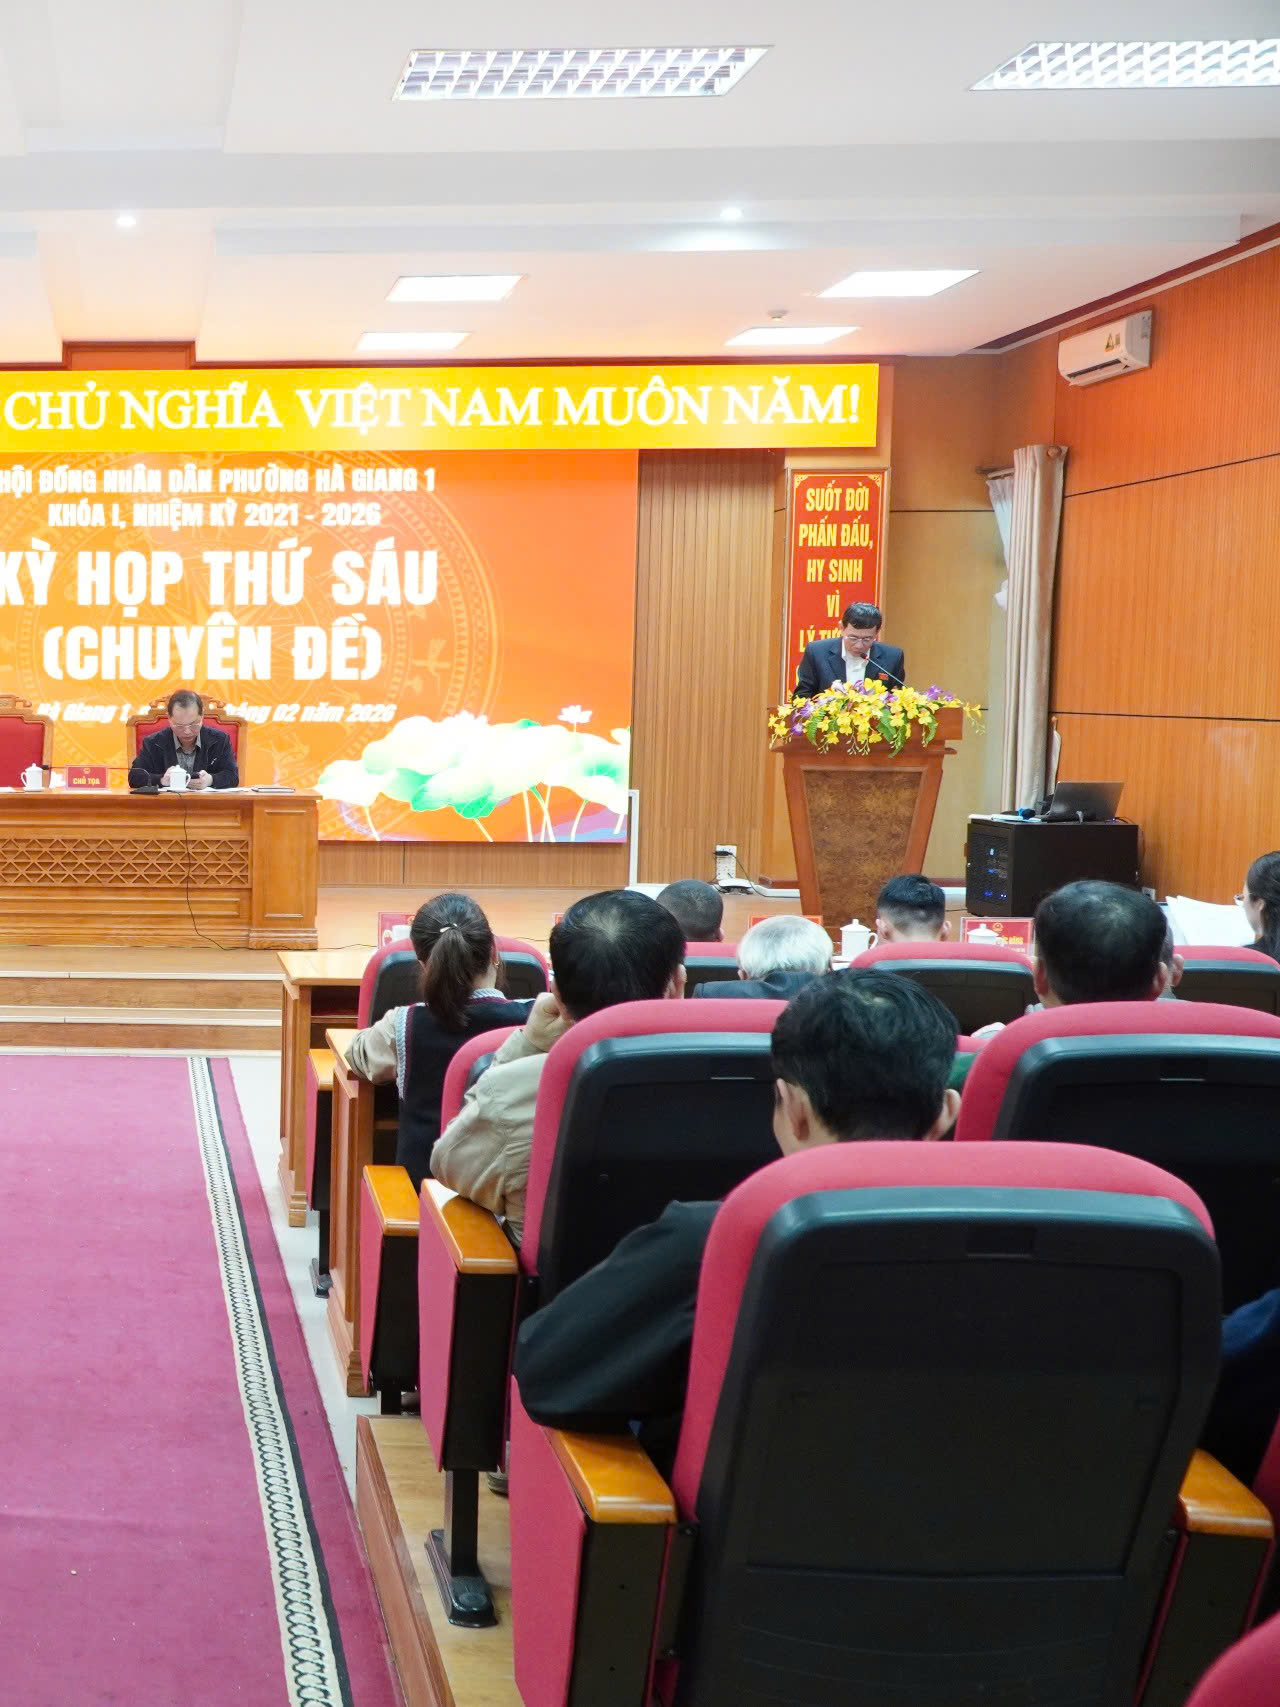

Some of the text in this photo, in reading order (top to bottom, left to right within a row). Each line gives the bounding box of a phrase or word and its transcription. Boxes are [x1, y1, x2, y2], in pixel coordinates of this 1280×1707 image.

[4, 380, 110, 430] CHỦ
[120, 380, 283, 430] NGHĨA
[295, 381, 412, 436] VIỆT
[421, 387, 544, 428] NAM
[554, 375, 713, 427] MUÔN
[723, 375, 861, 424] NĂM!
[103, 463, 162, 493] NHÂN
[168, 463, 213, 493] DÂN
[220, 462, 309, 493] PHƯỜNG
[315, 462, 345, 492] HÀ
[352, 468, 418, 492] GIANG
[424, 468, 435, 492] 1
[805, 479, 870, 512] SUỐT ĐỜI
[48, 498, 105, 527] KHÓA
[111, 503, 126, 529] I,
[133, 498, 204, 532] NHIỆM
[209, 498, 238, 527] KỲ
[244, 502, 299, 527] 2021
[321, 502, 382, 527] 2026
[798, 515, 873, 549] PHẤN ĐẤU,
[76, 550, 184, 618] HỌP
[203, 537, 313, 606] THỨ
[331, 537, 438, 606] SÁU
[806, 559, 863, 583] HY SINH
[826, 590, 840, 618] VÌ
[43, 612, 382, 681] (CHUYÊN ĐỀ)
[63, 702, 118, 723] Giang
[272, 703, 300, 722] 02
[300, 702, 344, 722] năm
[346, 703, 397, 722] 2026
[73, 775, 87, 785] CHỦ
